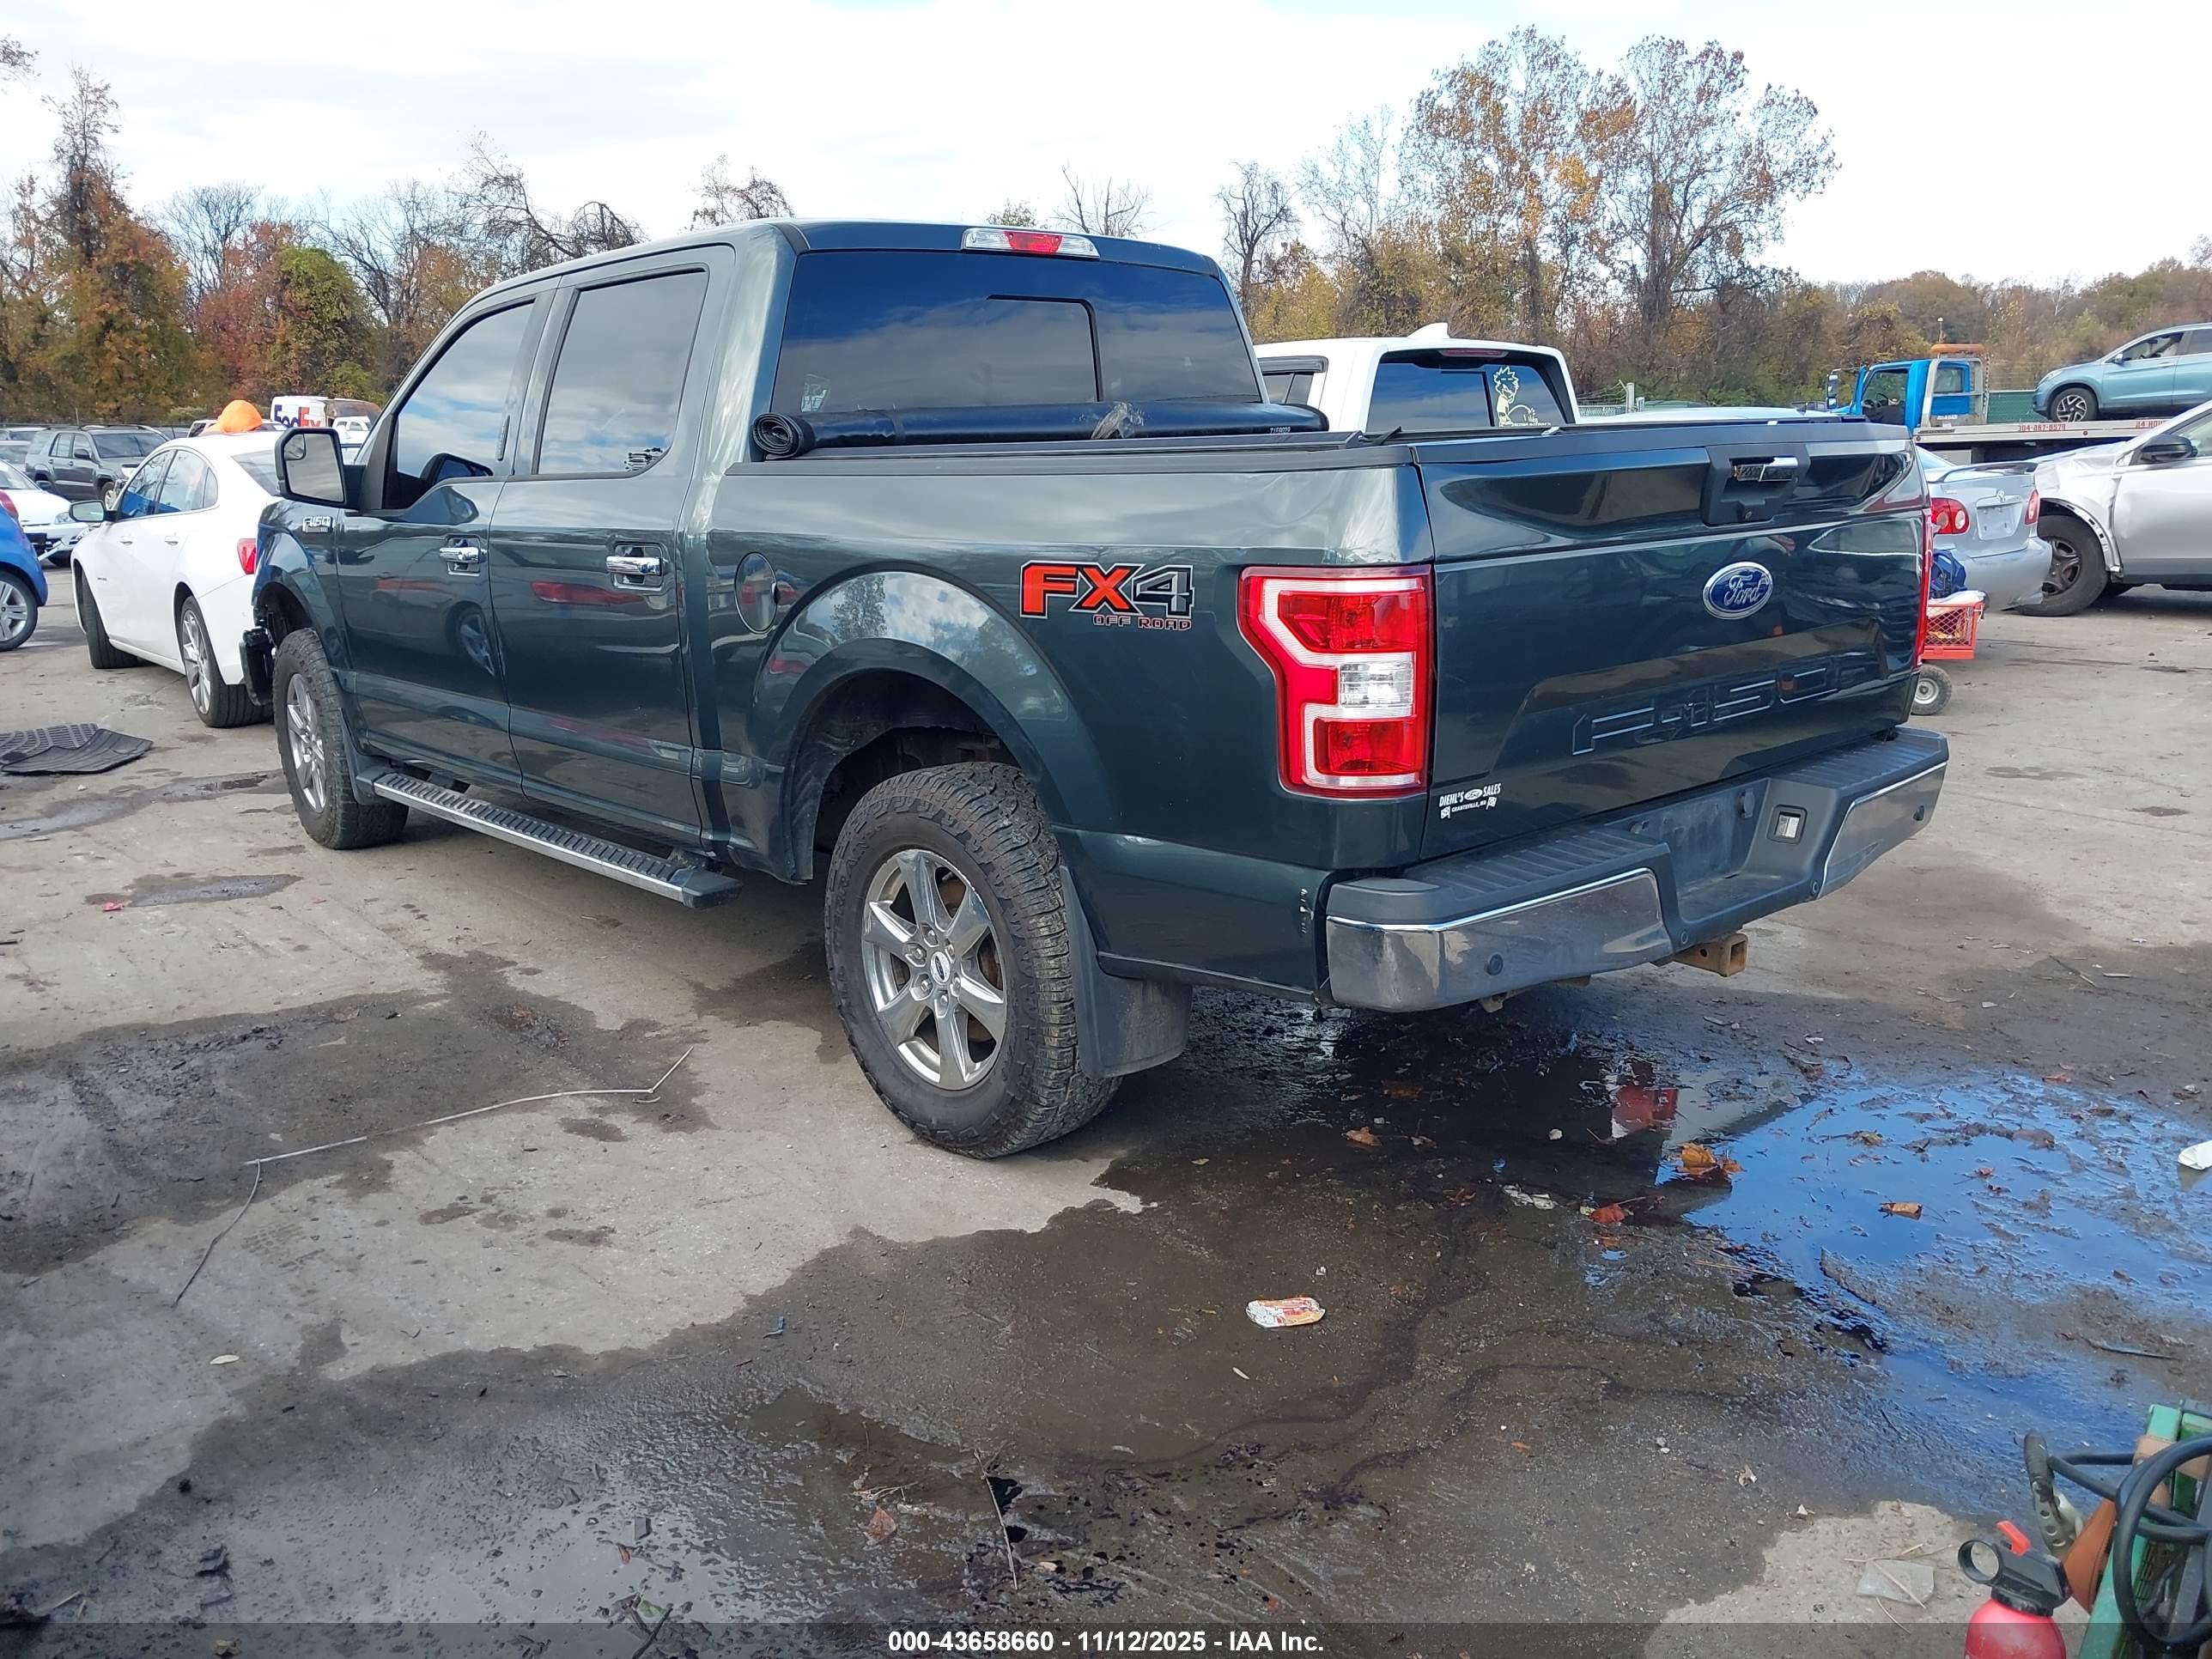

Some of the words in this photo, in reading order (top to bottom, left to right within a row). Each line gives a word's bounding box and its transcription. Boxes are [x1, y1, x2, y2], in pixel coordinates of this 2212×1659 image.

[275, 404, 322, 428] FedEx
[1019, 560, 1194, 619] FX4
[1723, 574, 1769, 606] Ford
[1093, 614, 1131, 627] OFF
[1138, 617, 1192, 630] ROAD
[1572, 660, 1839, 756] F-150
[1439, 791, 1464, 807] DIEHL'S
[1483, 782, 1502, 797] SALES
